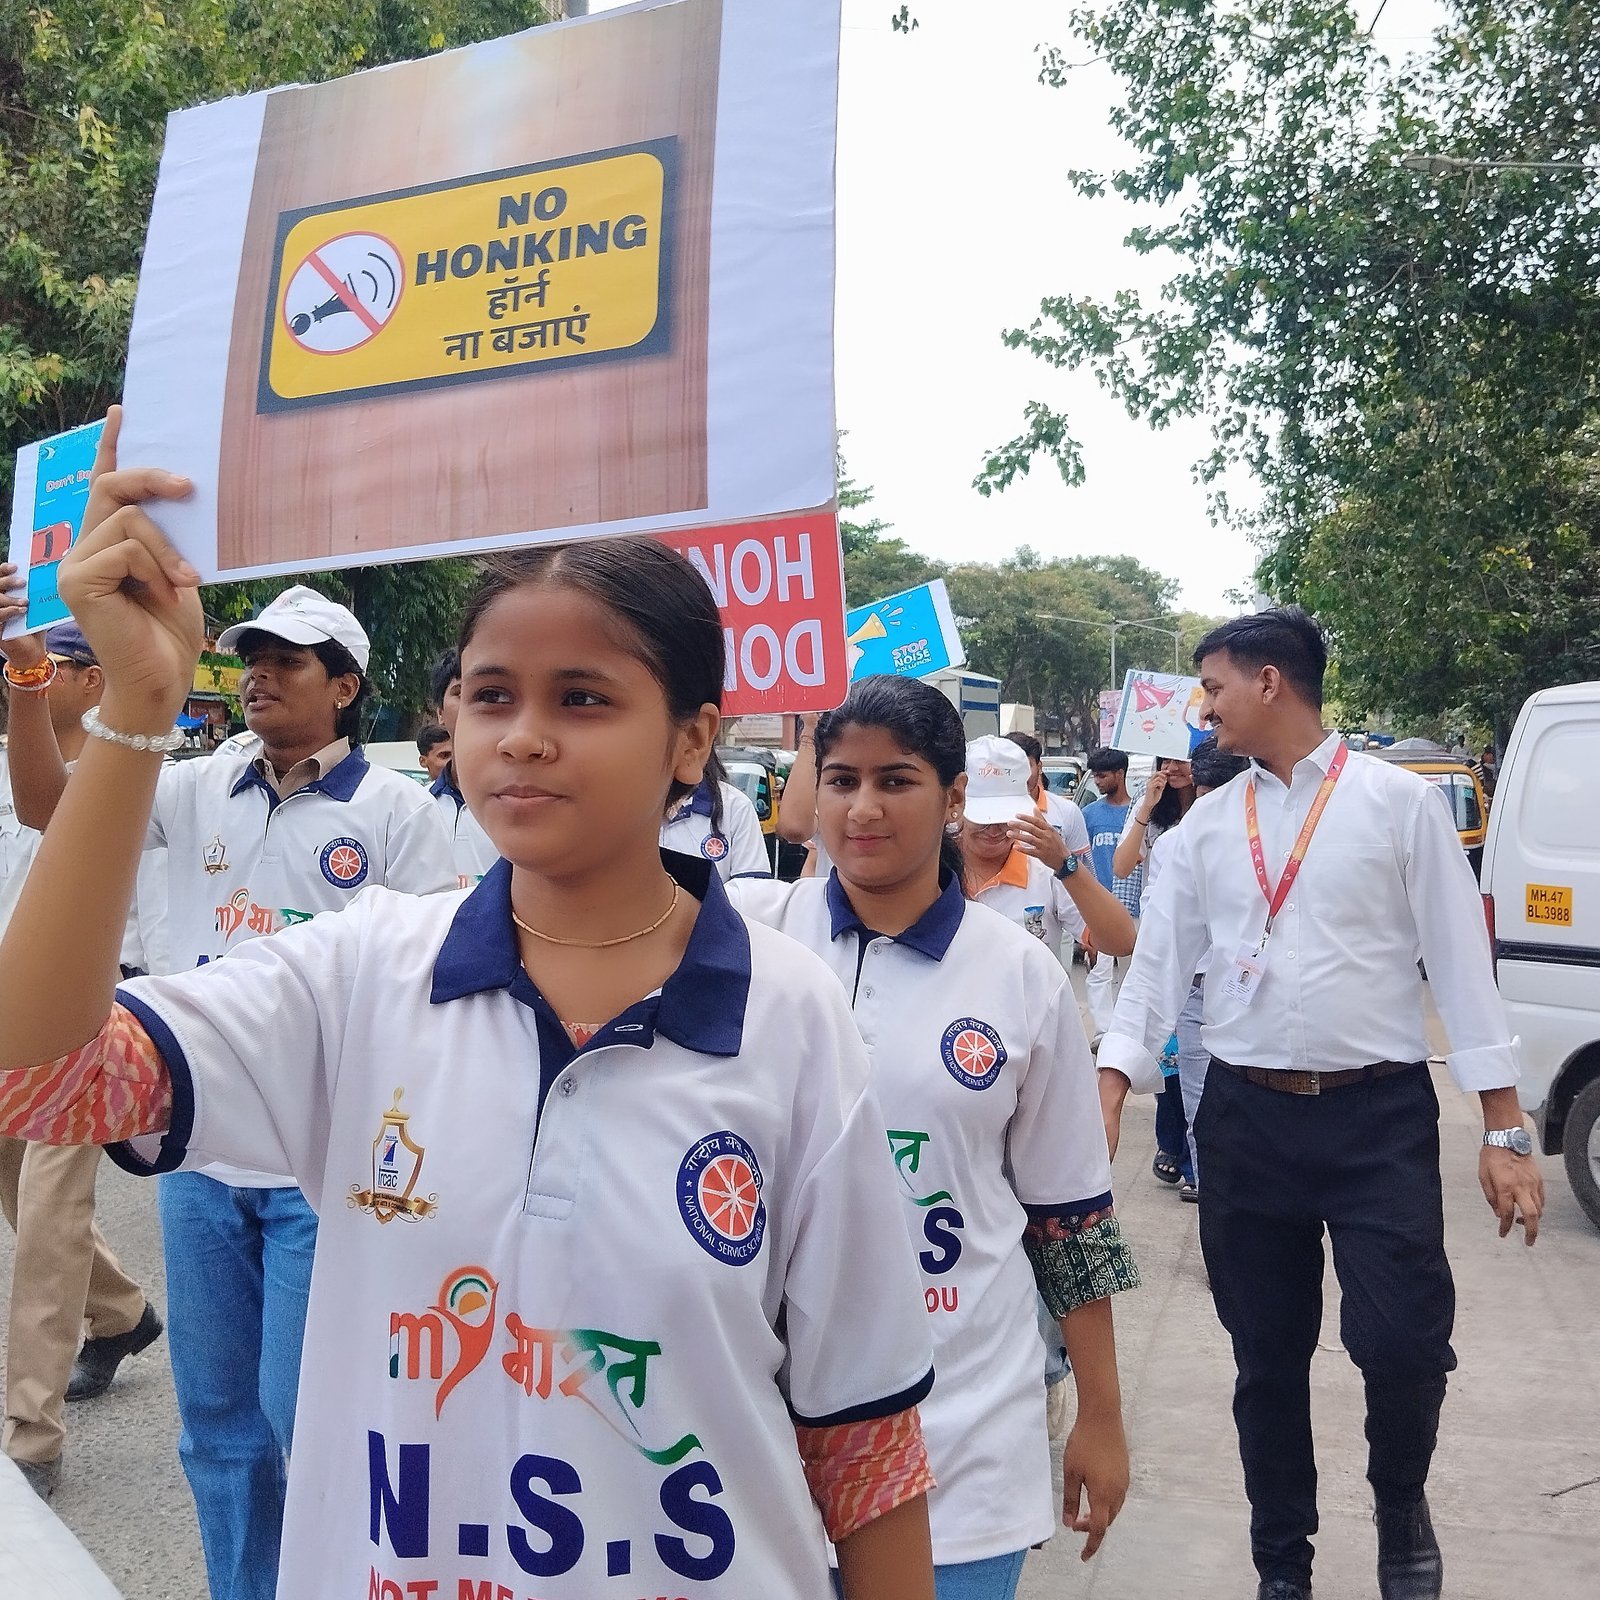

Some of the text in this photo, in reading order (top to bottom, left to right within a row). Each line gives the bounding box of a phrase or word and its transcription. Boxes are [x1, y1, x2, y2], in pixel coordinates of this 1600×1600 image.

[497, 186, 568, 229] NO
[414, 214, 648, 286] HONKING
[487, 269, 550, 320] हॉर्न
[444, 306, 590, 360] ना बजाएं
[676, 533, 815, 607] HON
[892, 638, 928, 659] STOP
[894, 648, 931, 668] NOISE
[1527, 904, 1570, 921] BL.3988
[1531, 889, 1563, 903] MH.47
[944, 1049, 965, 1080] NATIONAL
[684, 1195, 716, 1248] NATIONAL
[717, 1241, 748, 1258] SERVICE
[924, 1287, 959, 1312] OU
